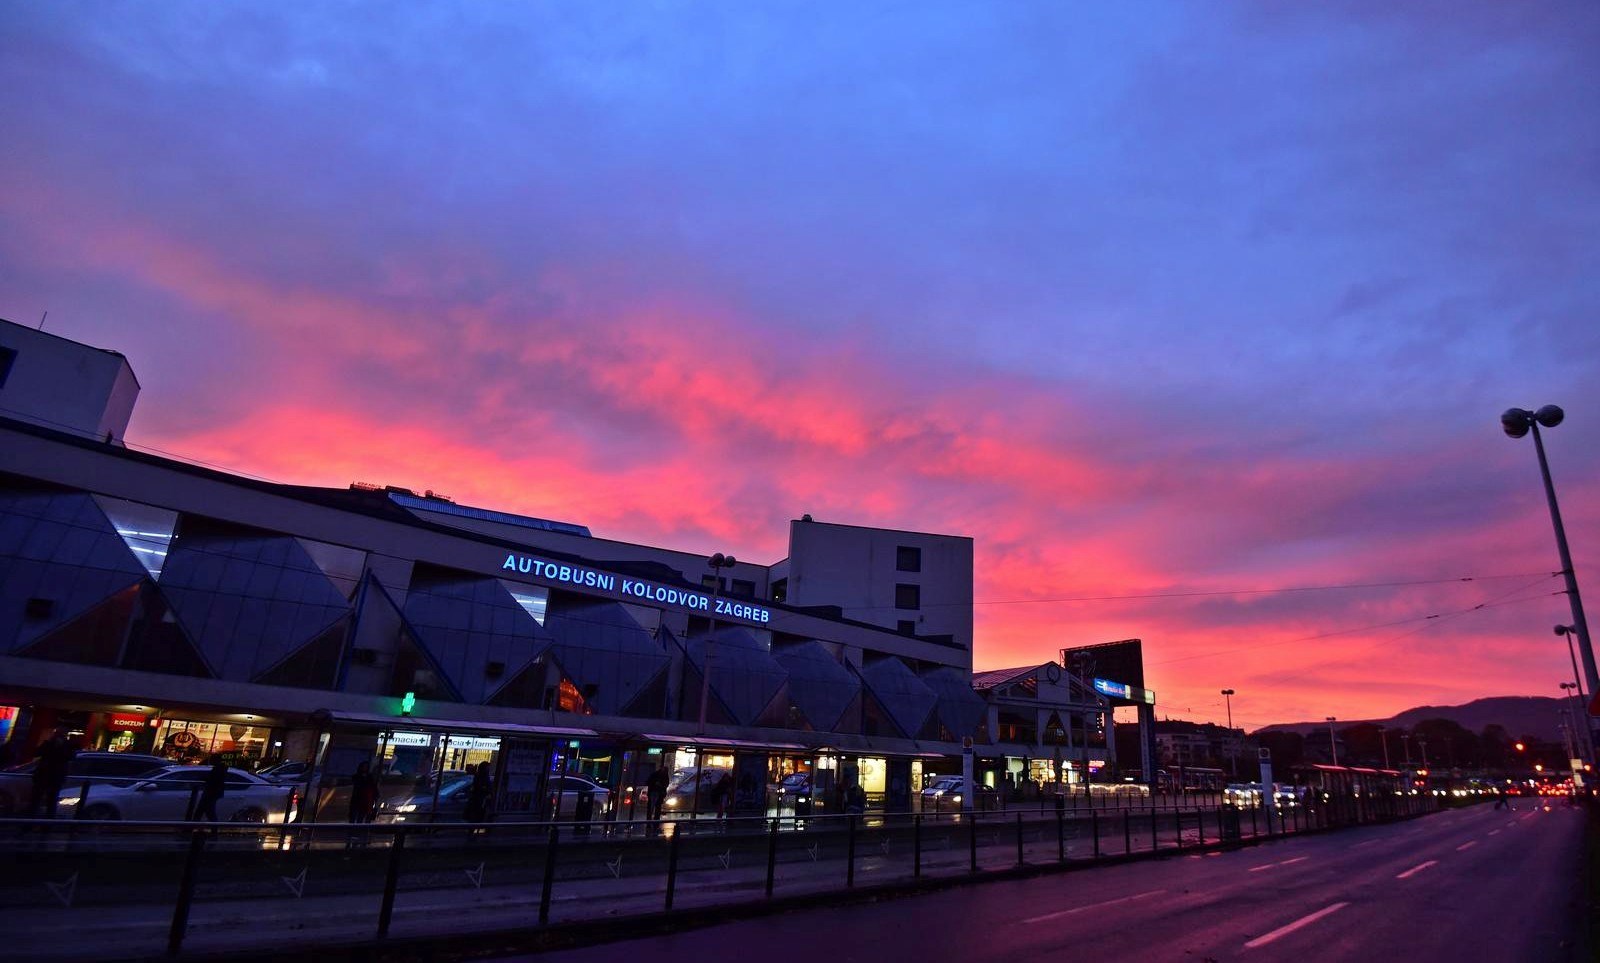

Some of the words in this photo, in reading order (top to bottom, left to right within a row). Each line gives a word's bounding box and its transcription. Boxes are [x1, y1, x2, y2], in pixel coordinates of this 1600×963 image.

[503, 555, 614, 590] AUTOBUSNI
[622, 580, 708, 610] KOLODVOR
[715, 600, 769, 622] ZAGREB
[113, 719, 145, 727] KONZUM
